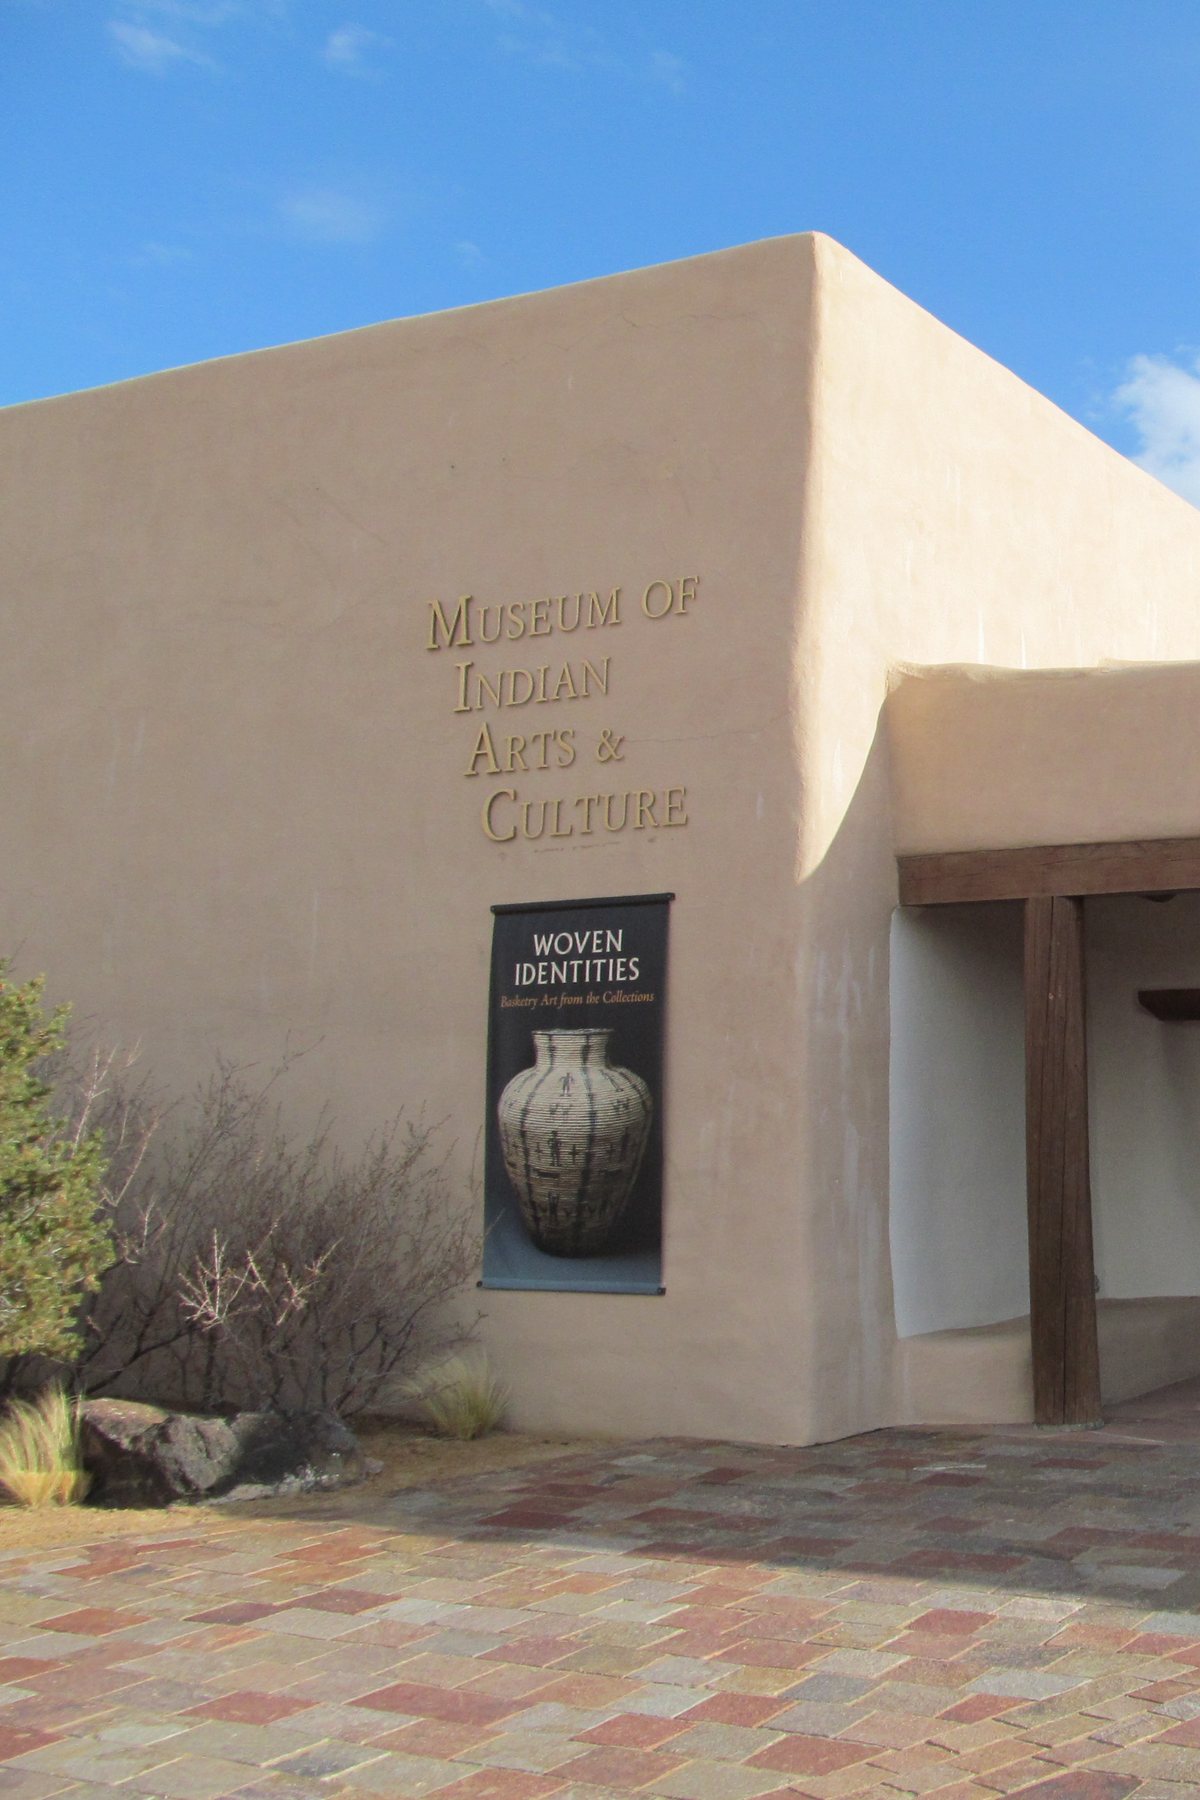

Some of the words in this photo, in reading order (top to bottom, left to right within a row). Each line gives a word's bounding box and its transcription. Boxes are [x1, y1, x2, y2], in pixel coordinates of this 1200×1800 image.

[426, 586, 622, 651] MUSEUM
[641, 575, 699, 619] OF
[453, 656, 611, 713] INDIAN
[463, 721, 576, 777] ARTS
[597, 728, 625, 762] &
[481, 785, 689, 842] CULTURE
[533, 929, 623, 956] WOVEN
[514, 957, 640, 986] IDENTITIES
[500, 994, 538, 1010] Basketry
[540, 993, 558, 1006] Art
[558, 992, 583, 1009] from
[586, 991, 600, 1005] the
[602, 990, 655, 1004] Collections
